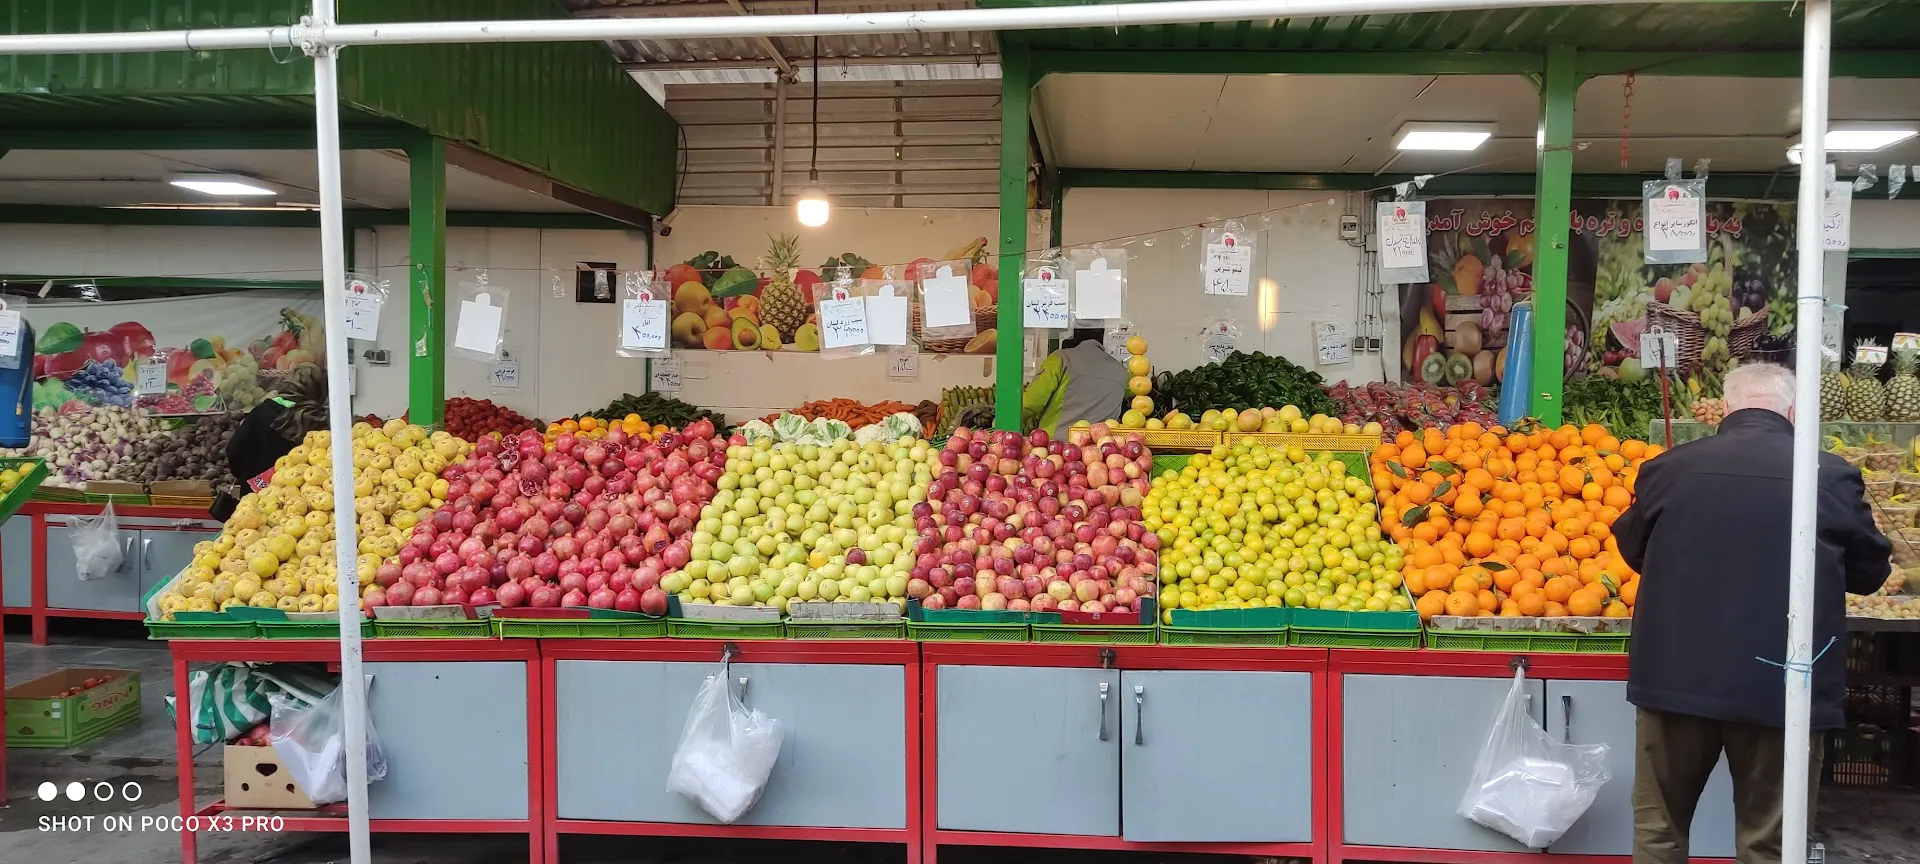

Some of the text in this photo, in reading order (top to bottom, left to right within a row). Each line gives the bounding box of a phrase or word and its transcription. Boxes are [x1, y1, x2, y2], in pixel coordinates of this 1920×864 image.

[1467, 210, 1518, 236] خوش
[1569, 210, 1585, 235] با
[1586, 210, 1617, 236] تره
[1618, 219, 1631, 236] و
[1722, 217, 1743, 238] به
